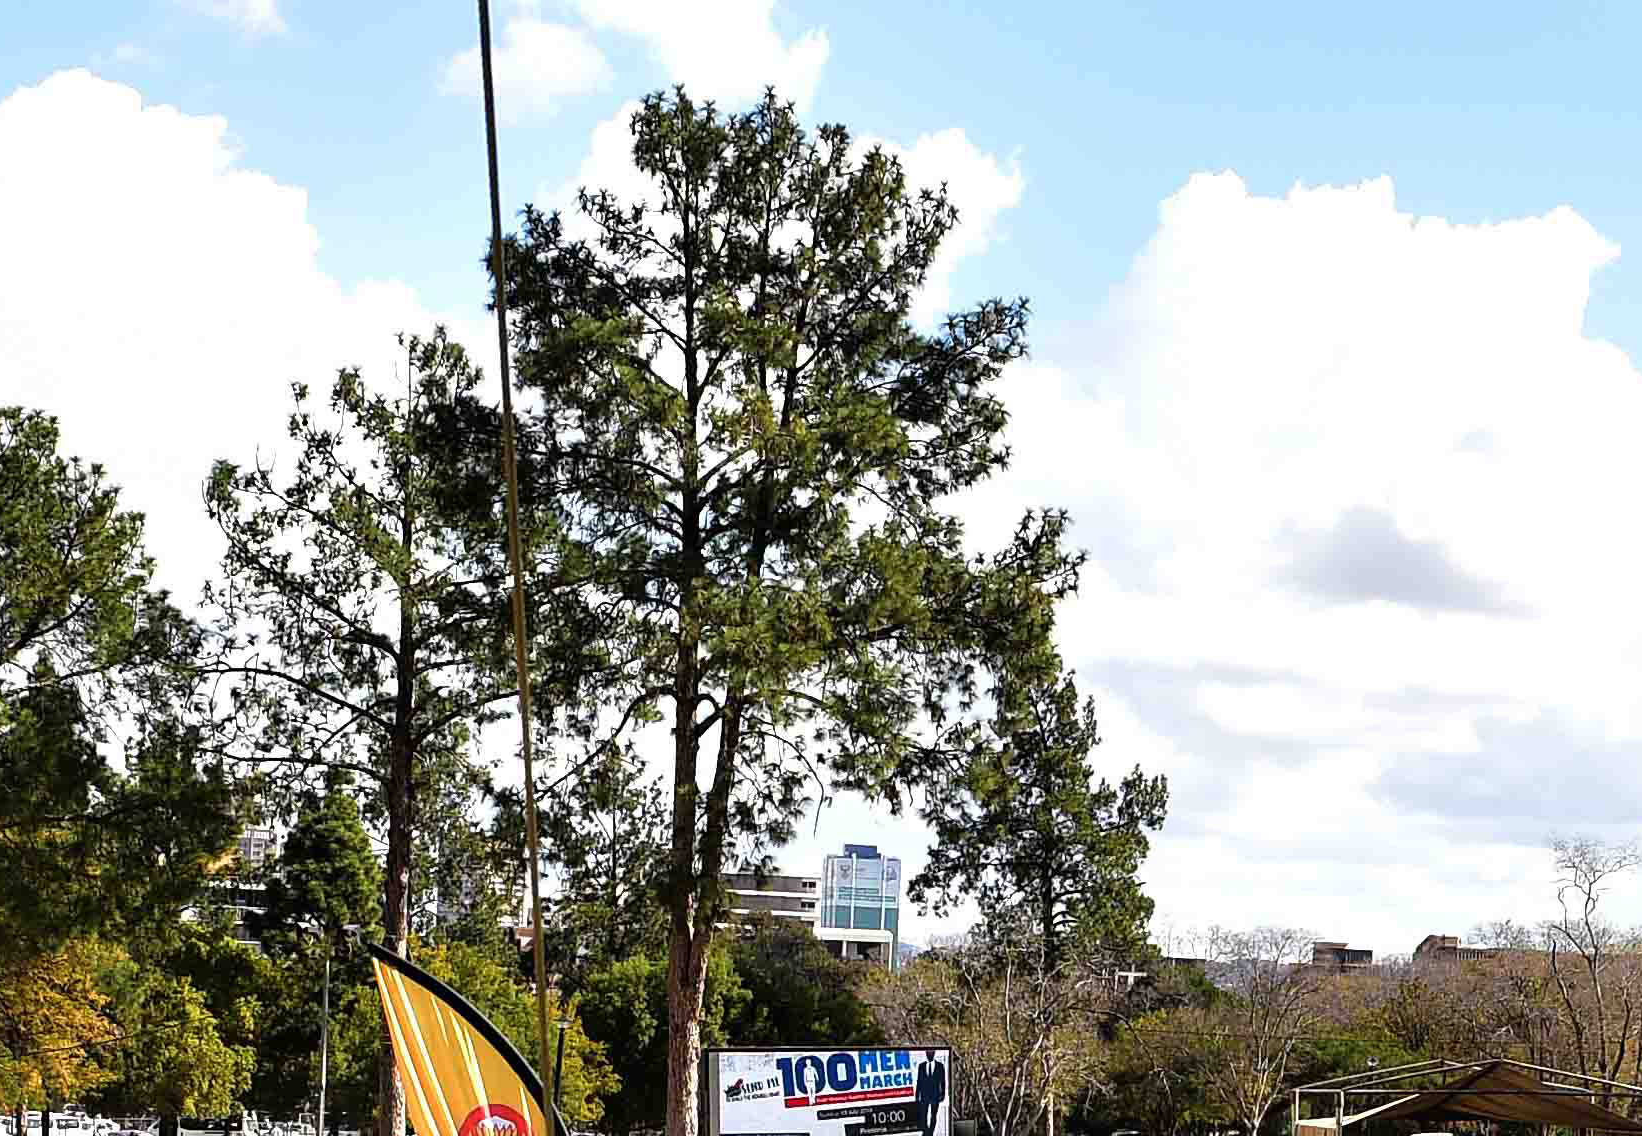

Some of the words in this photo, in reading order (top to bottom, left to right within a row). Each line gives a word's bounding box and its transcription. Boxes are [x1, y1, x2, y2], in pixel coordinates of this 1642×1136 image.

[776, 1053, 857, 1096] 100
[858, 1051, 912, 1074] MEN
[859, 1072, 914, 1090] MARCH
[871, 1109, 905, 1125] 10:00
